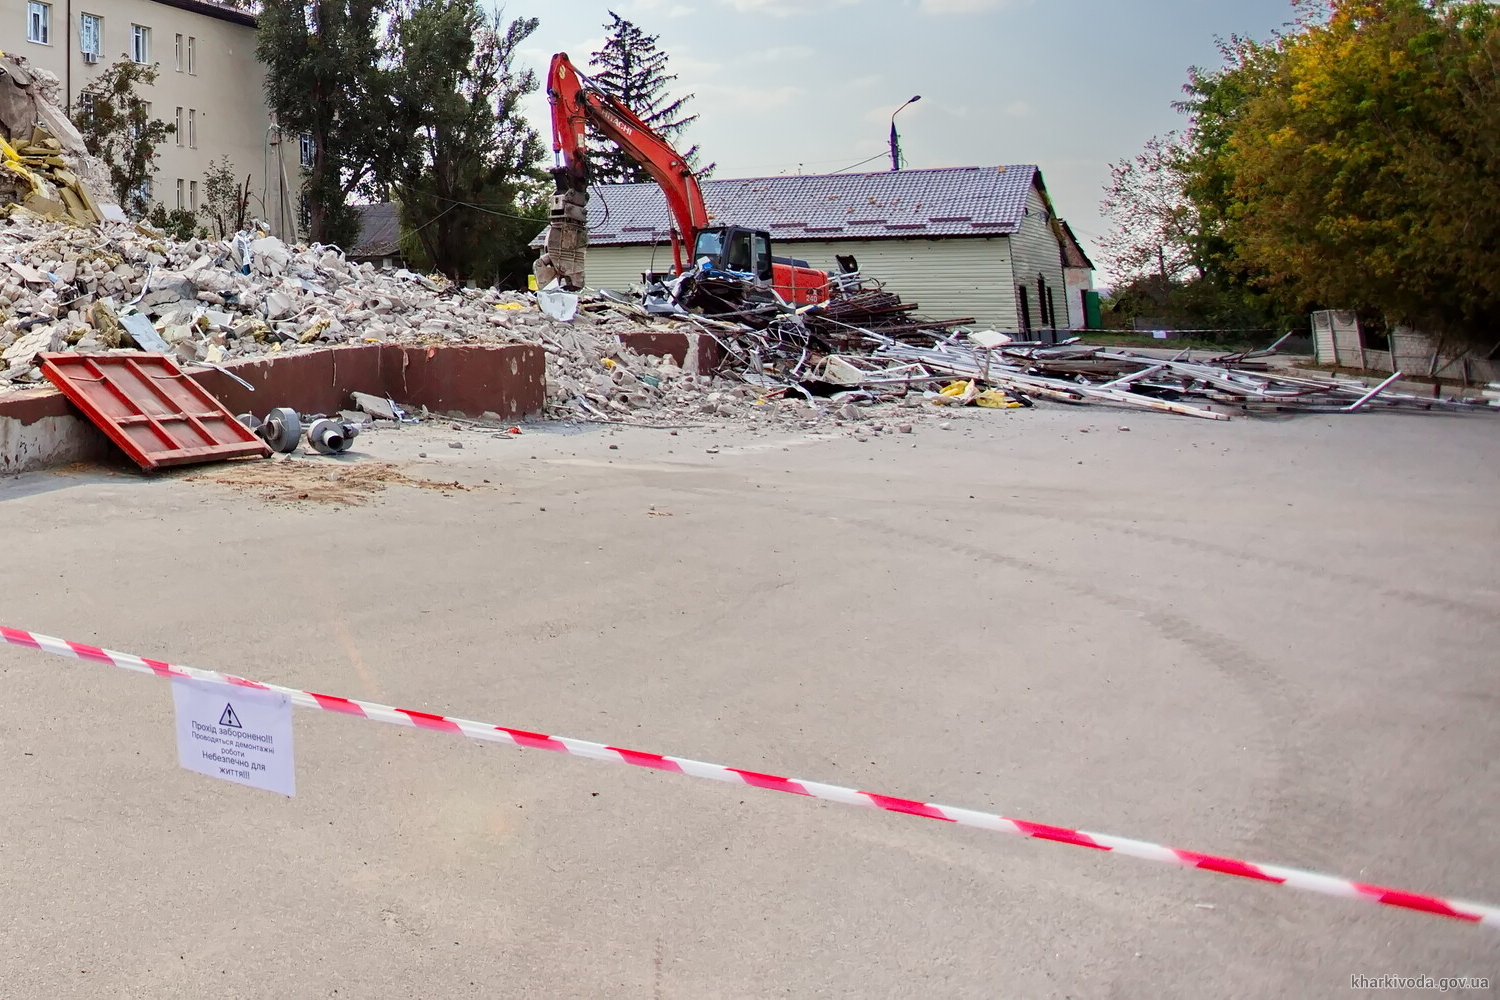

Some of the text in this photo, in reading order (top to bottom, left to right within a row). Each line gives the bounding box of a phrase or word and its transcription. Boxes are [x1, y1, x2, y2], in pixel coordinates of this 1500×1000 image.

[806, 294, 818, 302] 240
[192, 720, 273, 744] Прохід заборонено!!!
[192, 731, 275, 754] Проводяться демонтажні
[202, 750, 266, 771] Небезпечно для
[221, 747, 245, 758] роботи
[219, 767, 250, 779] життя!!!
